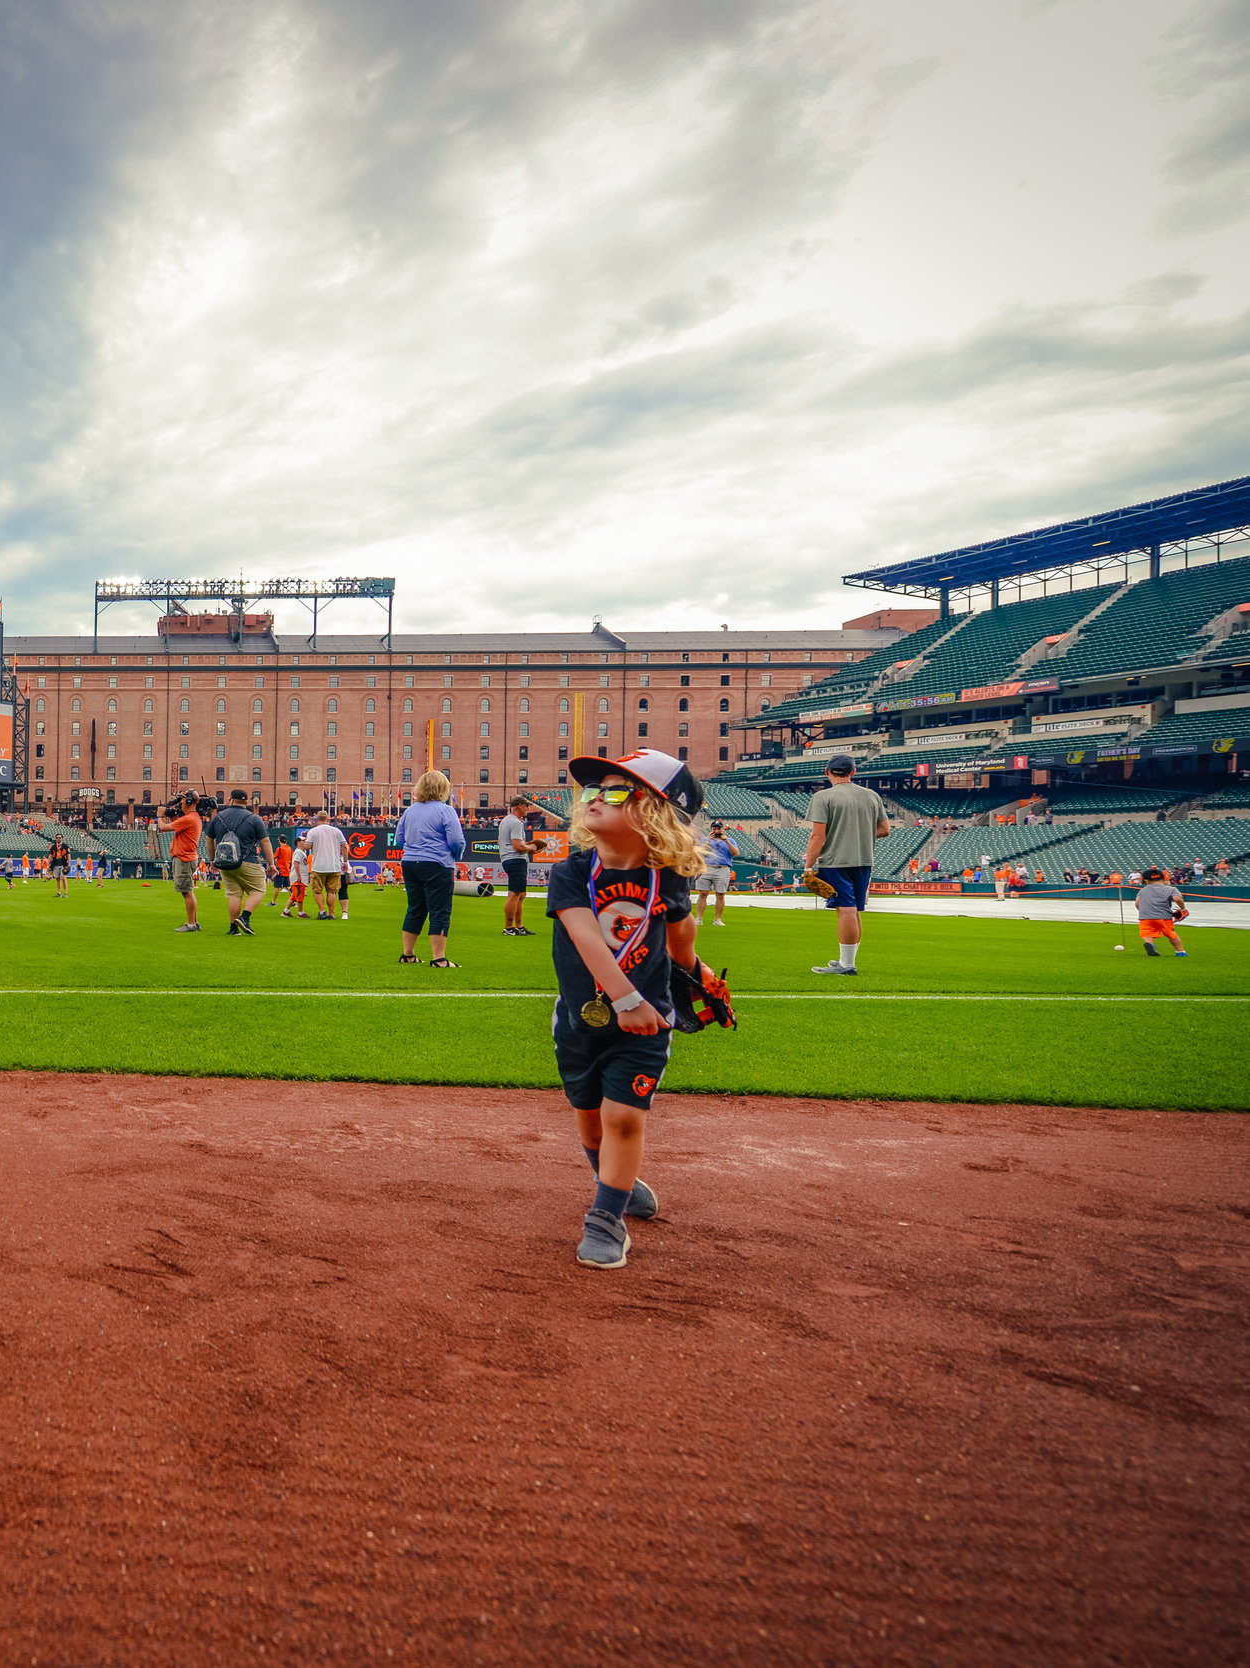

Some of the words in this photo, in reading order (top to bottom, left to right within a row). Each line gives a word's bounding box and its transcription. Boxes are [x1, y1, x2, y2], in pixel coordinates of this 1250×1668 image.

[935, 760, 966, 769] University
[975, 758, 1006, 767] Maryland
[903, 883, 938, 891] CHATTER'S
